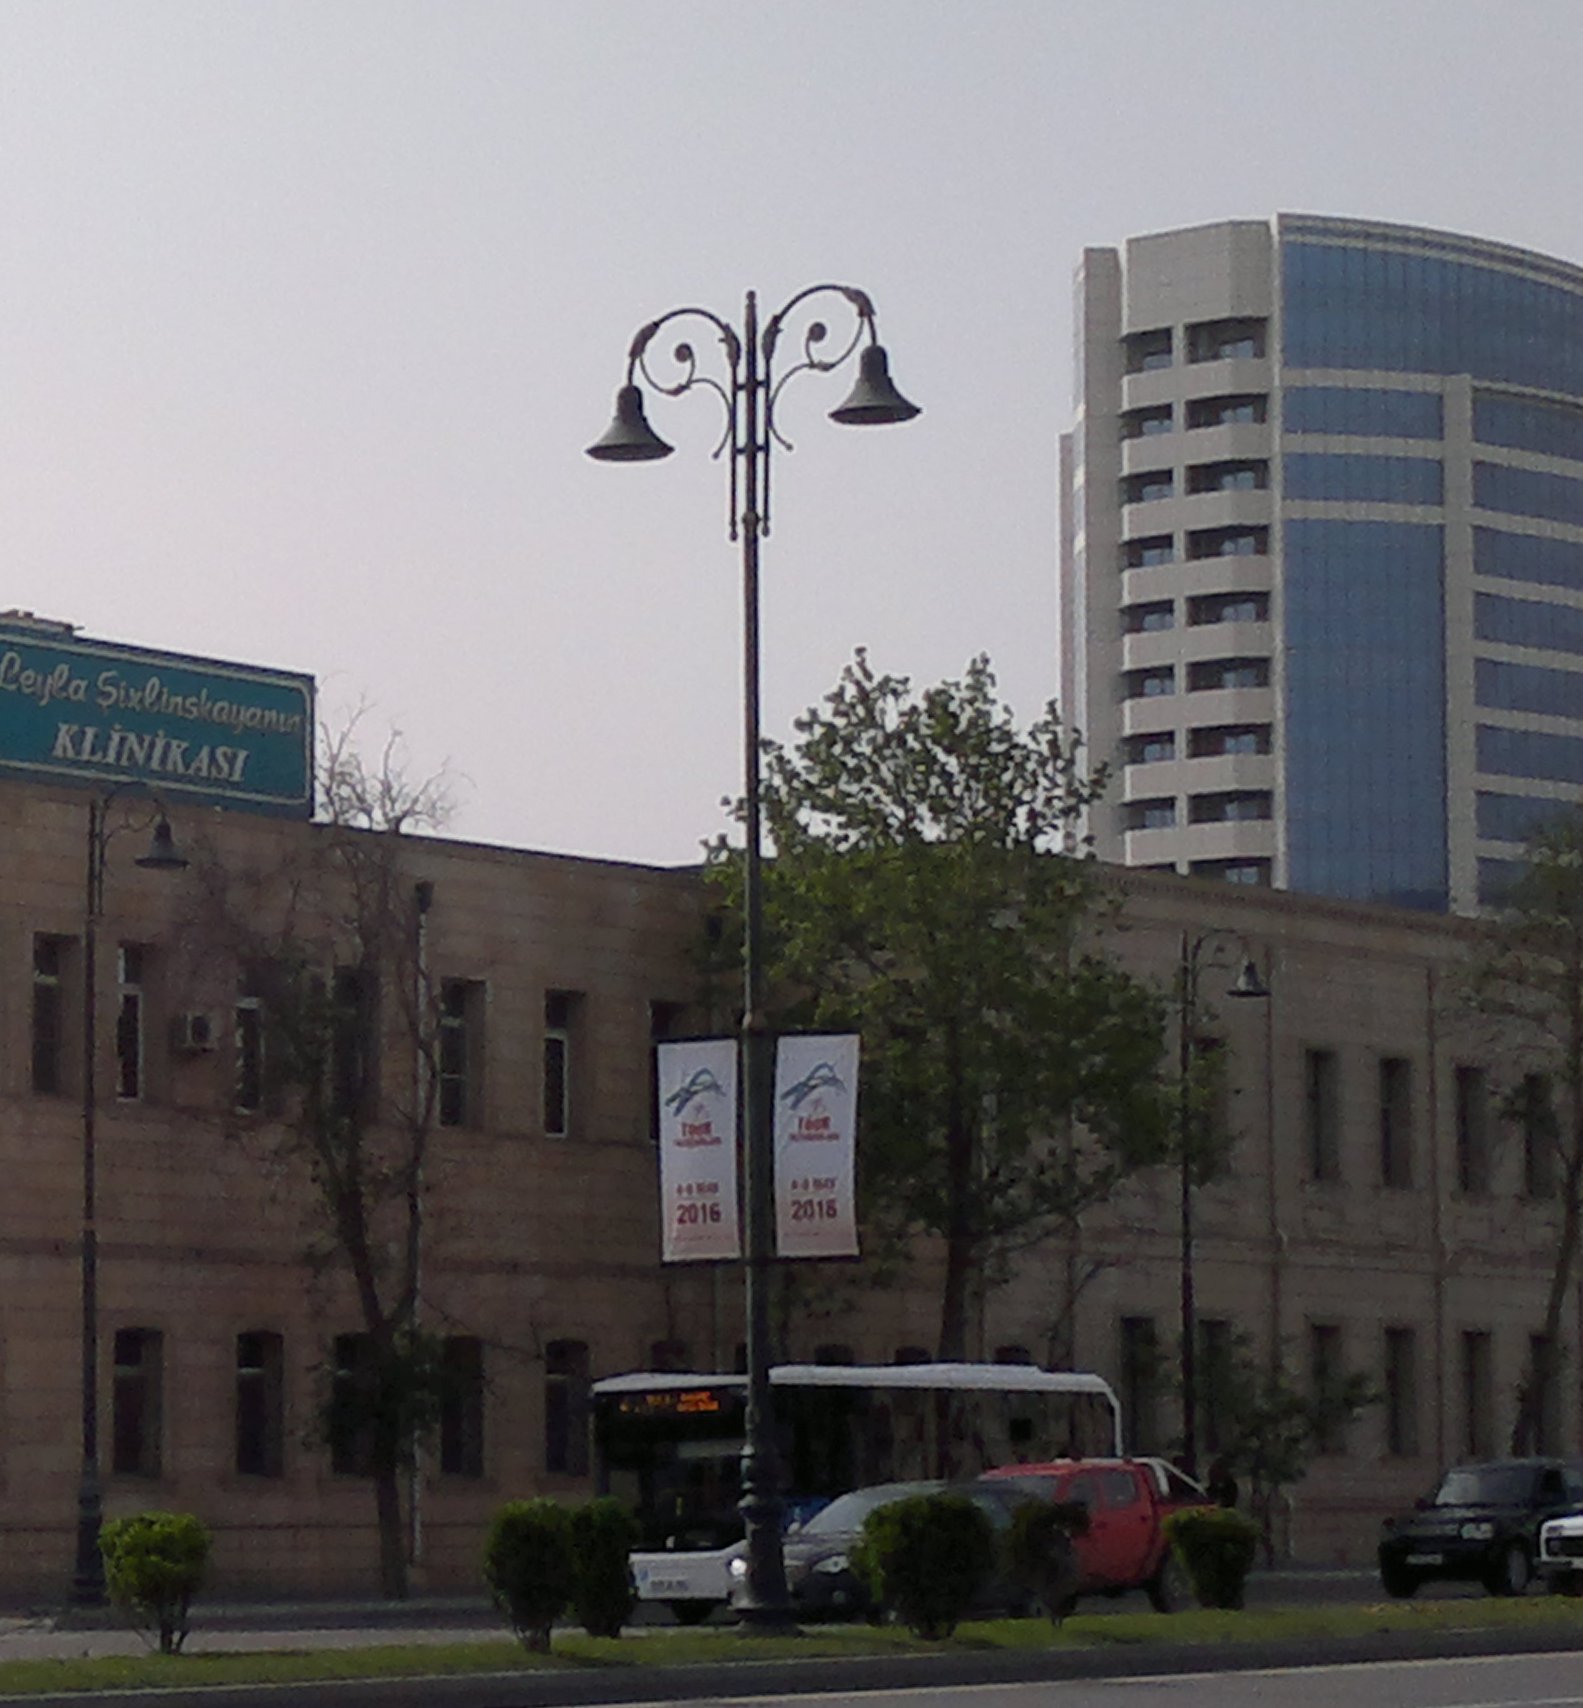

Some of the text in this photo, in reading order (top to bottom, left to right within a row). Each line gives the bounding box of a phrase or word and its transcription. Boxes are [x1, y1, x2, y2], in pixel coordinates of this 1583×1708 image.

[52, 723, 249, 782] KLİNİKASI
[677, 1202, 721, 1225] 2016
[791, 1199, 838, 1221] 2016
